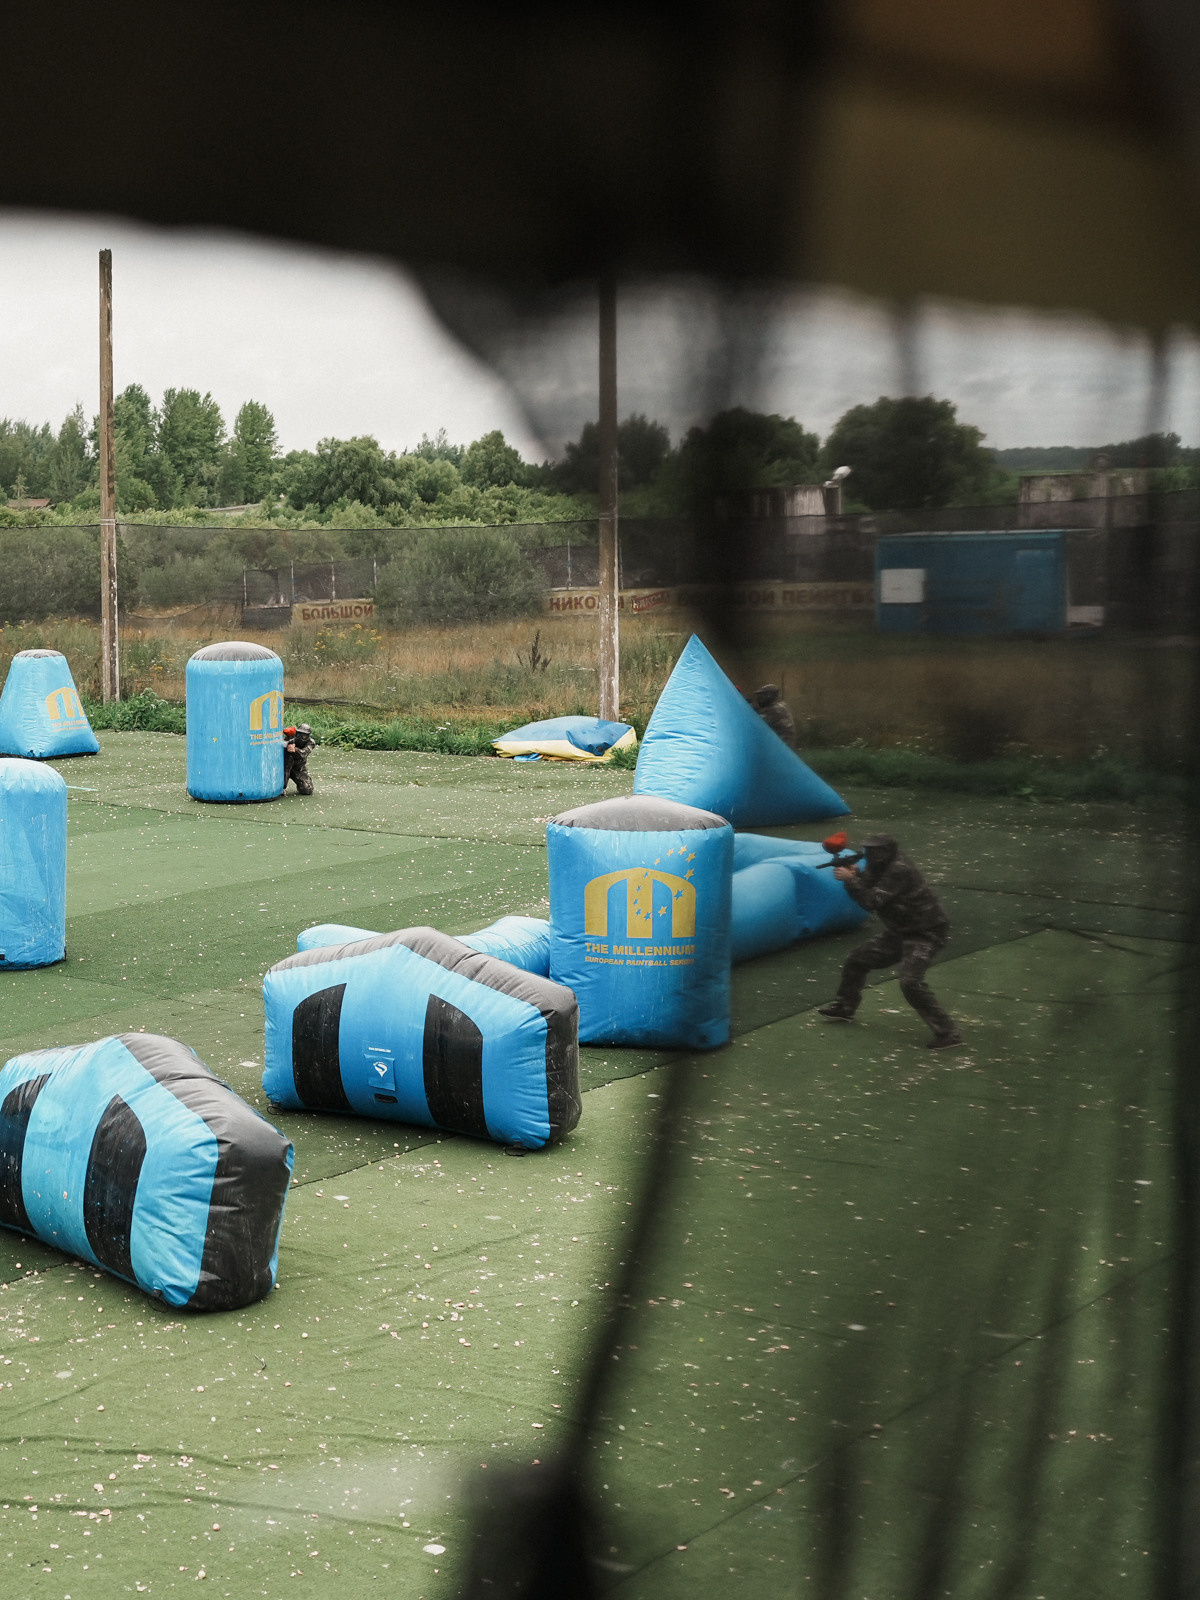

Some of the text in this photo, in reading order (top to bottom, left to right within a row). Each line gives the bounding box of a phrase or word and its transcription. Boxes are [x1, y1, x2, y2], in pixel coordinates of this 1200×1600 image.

[584, 942, 695, 956] THE MILLENNIUM
[585, 956, 625, 966] EUROPEAN
[626, 959, 668, 967] PAINTBALL
